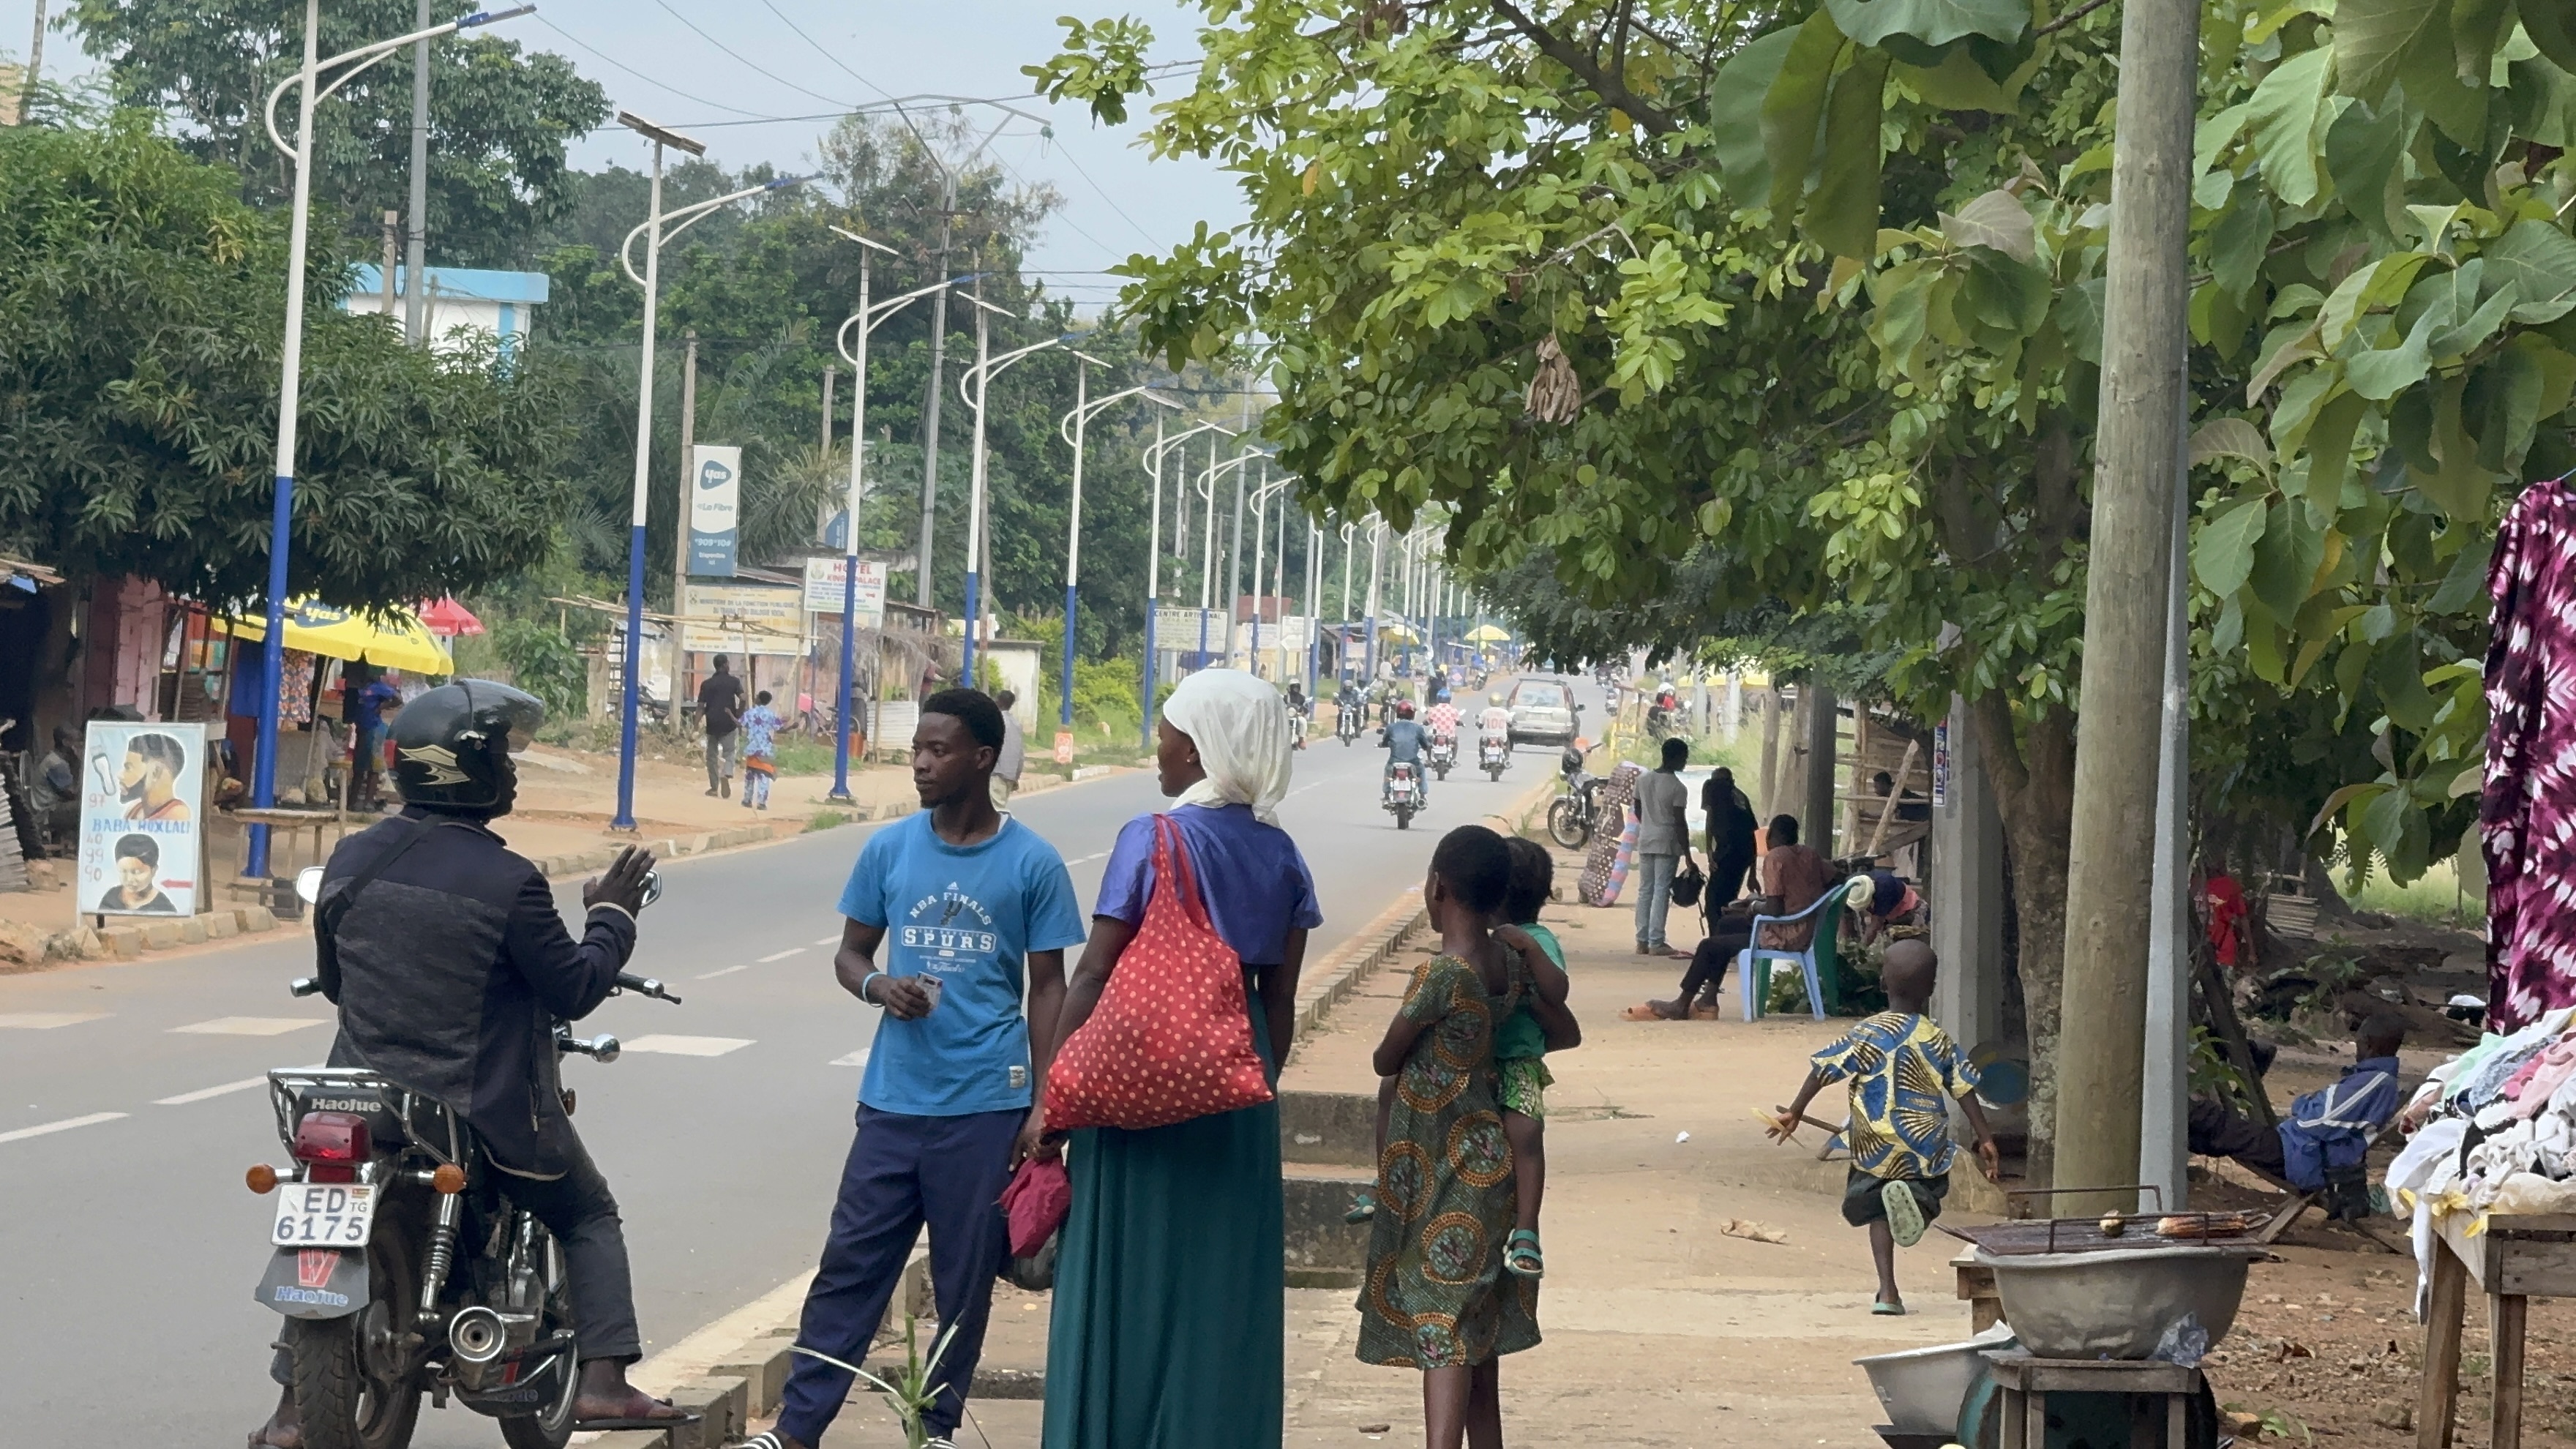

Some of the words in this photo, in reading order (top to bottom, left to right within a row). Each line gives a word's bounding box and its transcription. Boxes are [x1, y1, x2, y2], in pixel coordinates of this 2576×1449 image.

[705, 469, 727, 484] yas
[92, 818, 131, 833] BABA
[910, 895, 937, 918] NBA
[943, 892, 992, 925] FINALS
[905, 928, 992, 950] SPURS
[304, 1188, 346, 1213] ED
[350, 1201, 368, 1212] TG
[277, 1216, 364, 1241] 6175
